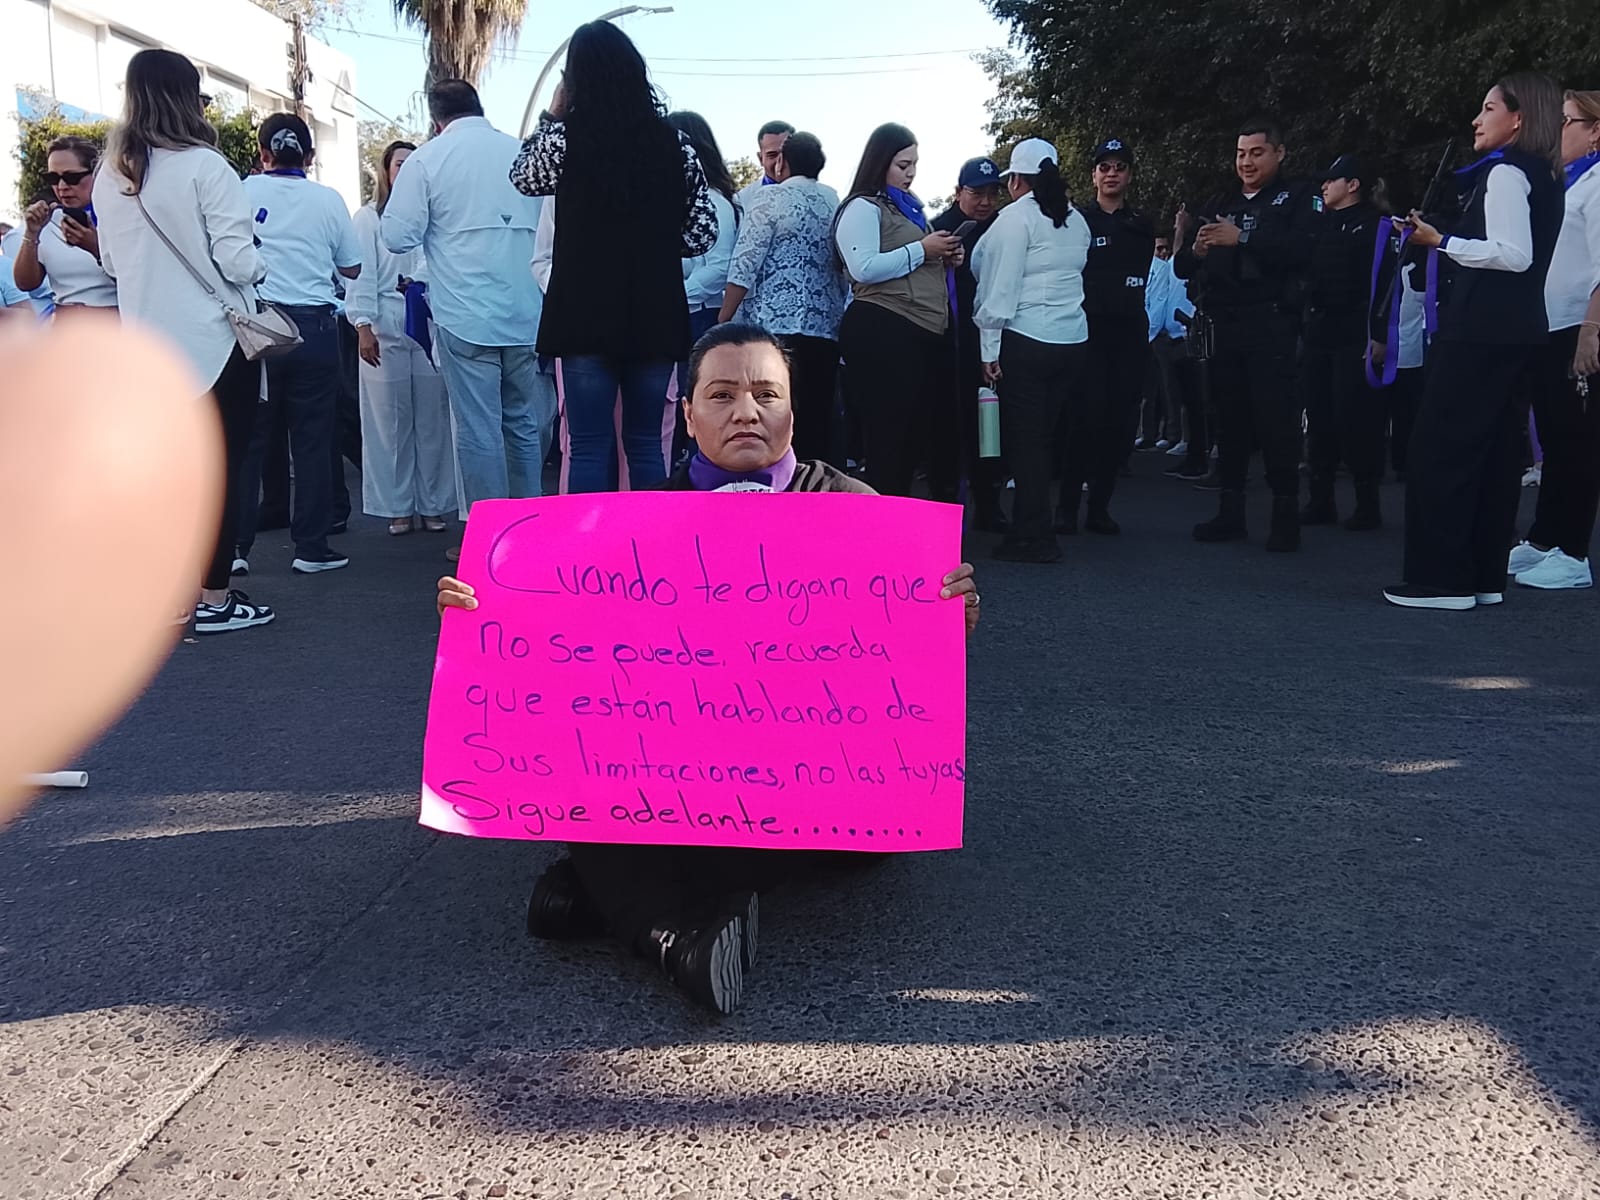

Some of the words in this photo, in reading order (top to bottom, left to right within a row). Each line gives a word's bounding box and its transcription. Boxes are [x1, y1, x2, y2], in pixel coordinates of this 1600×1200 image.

[487, 512, 678, 606] Cuando
[693, 533, 733, 604] te
[744, 542, 850, 626] digan
[867, 574, 936, 624] que
[745, 626, 891, 665] recuerda
[464, 683, 544, 738] que
[570, 673, 676, 725] están
[691, 677, 869, 725] hablando
[884, 676, 935, 723] de
[462, 731, 554, 776] Sus
[575, 728, 786, 791] limitaciones,
[793, 761, 836, 786] no
[839, 739, 886, 785] las
[893, 737, 965, 796] tuyas
[440, 778, 592, 836] Sigue
